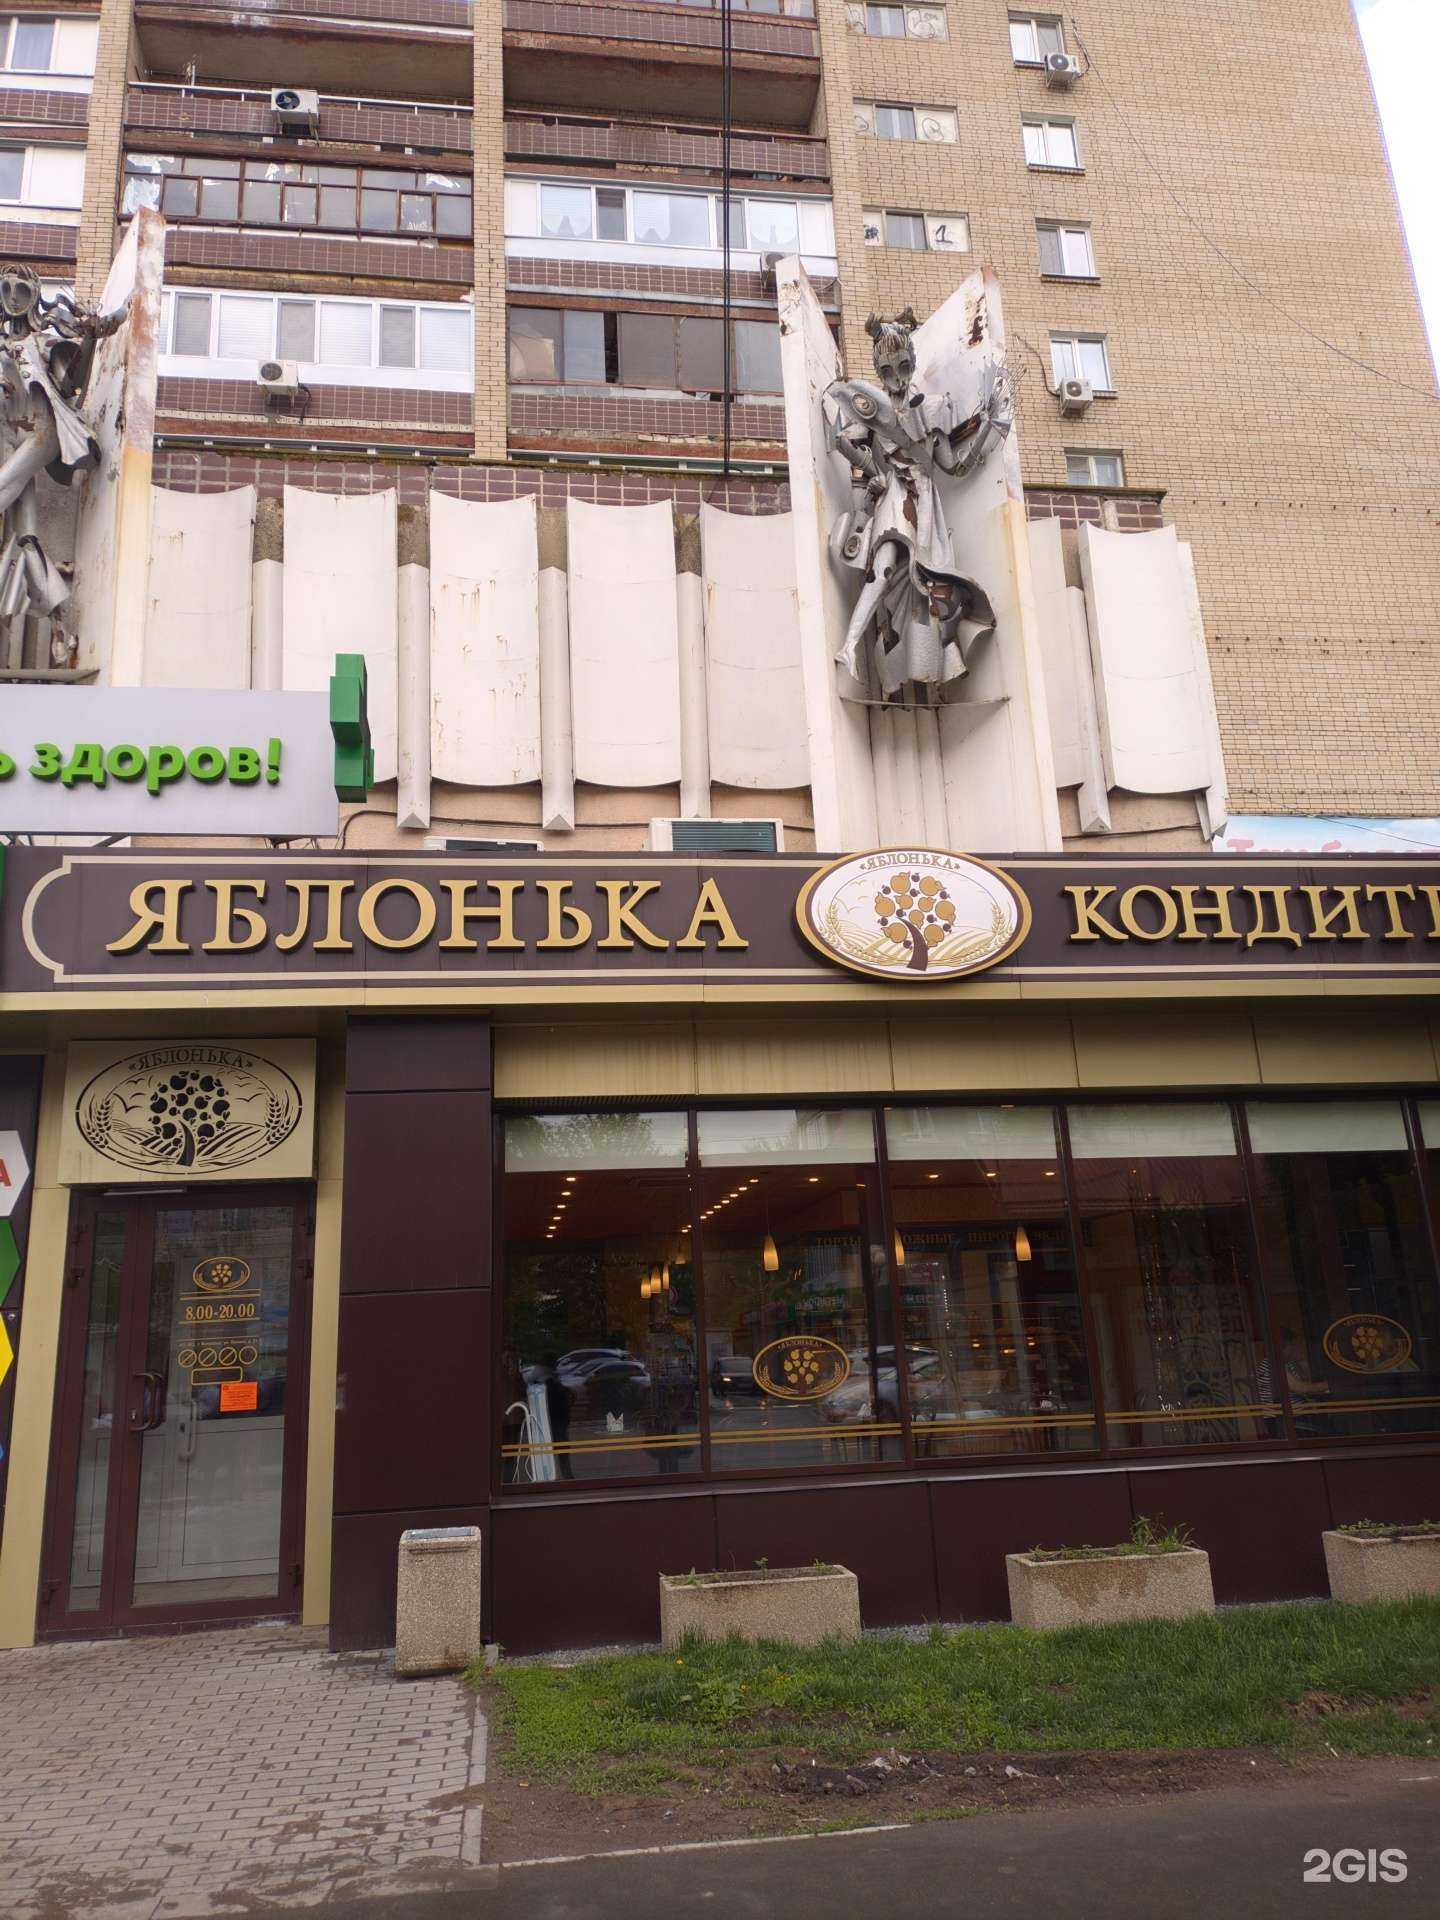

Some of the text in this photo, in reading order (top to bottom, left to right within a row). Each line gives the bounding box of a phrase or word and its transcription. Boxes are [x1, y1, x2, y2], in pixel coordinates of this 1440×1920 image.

[28, 737, 282, 796] здоров!
[859, 852, 961, 870] «ЯБЛОНЬКА»
[105, 877, 749, 951] ЯБЛОНЬКА
[128, 1048, 253, 1072] «ЯБЛОНЬКА»
